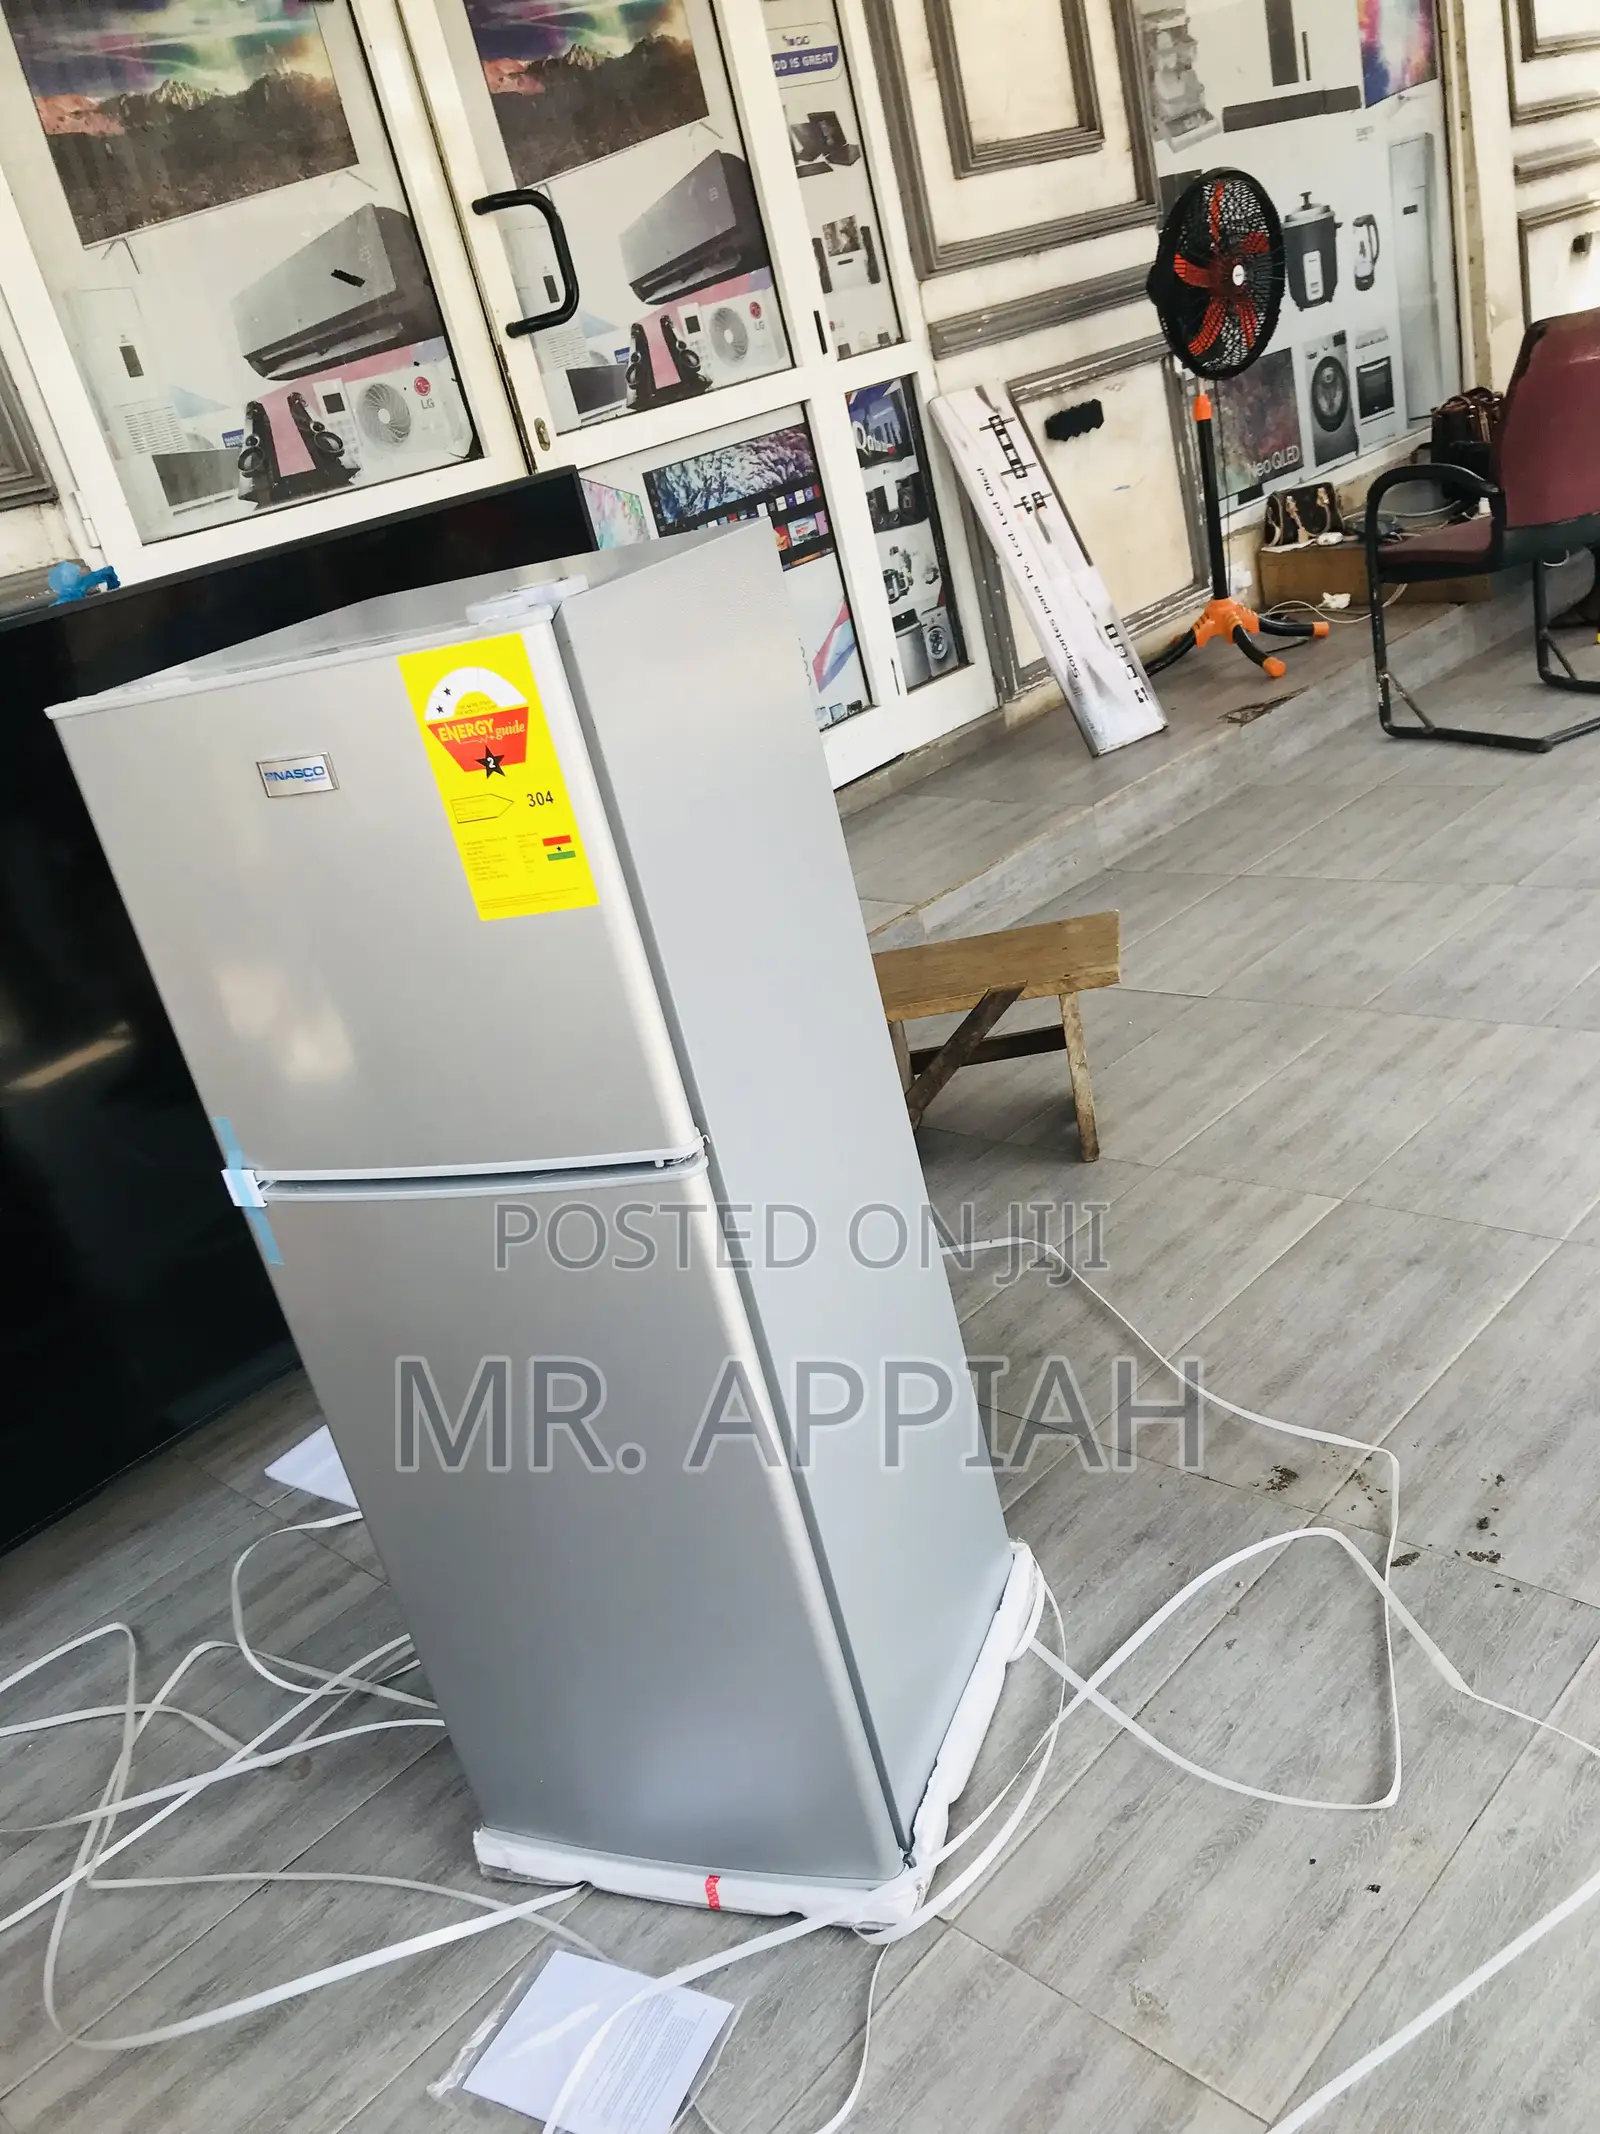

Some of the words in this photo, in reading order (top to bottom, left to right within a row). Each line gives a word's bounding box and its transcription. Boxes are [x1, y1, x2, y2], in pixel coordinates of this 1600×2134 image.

[773, 59, 788, 70] OD
[789, 56, 800, 68] IS
[802, 52, 834, 66] GREAT
[420, 398, 435, 409] LG
[1033, 585, 1052, 615] para
[1049, 617, 1081, 679] Soportes
[438, 718, 494, 744] ENERGY
[495, 719, 526, 741] guide
[487, 756, 496, 769] 2
[273, 765, 325, 781] NASCO
[526, 790, 554, 807] 304
